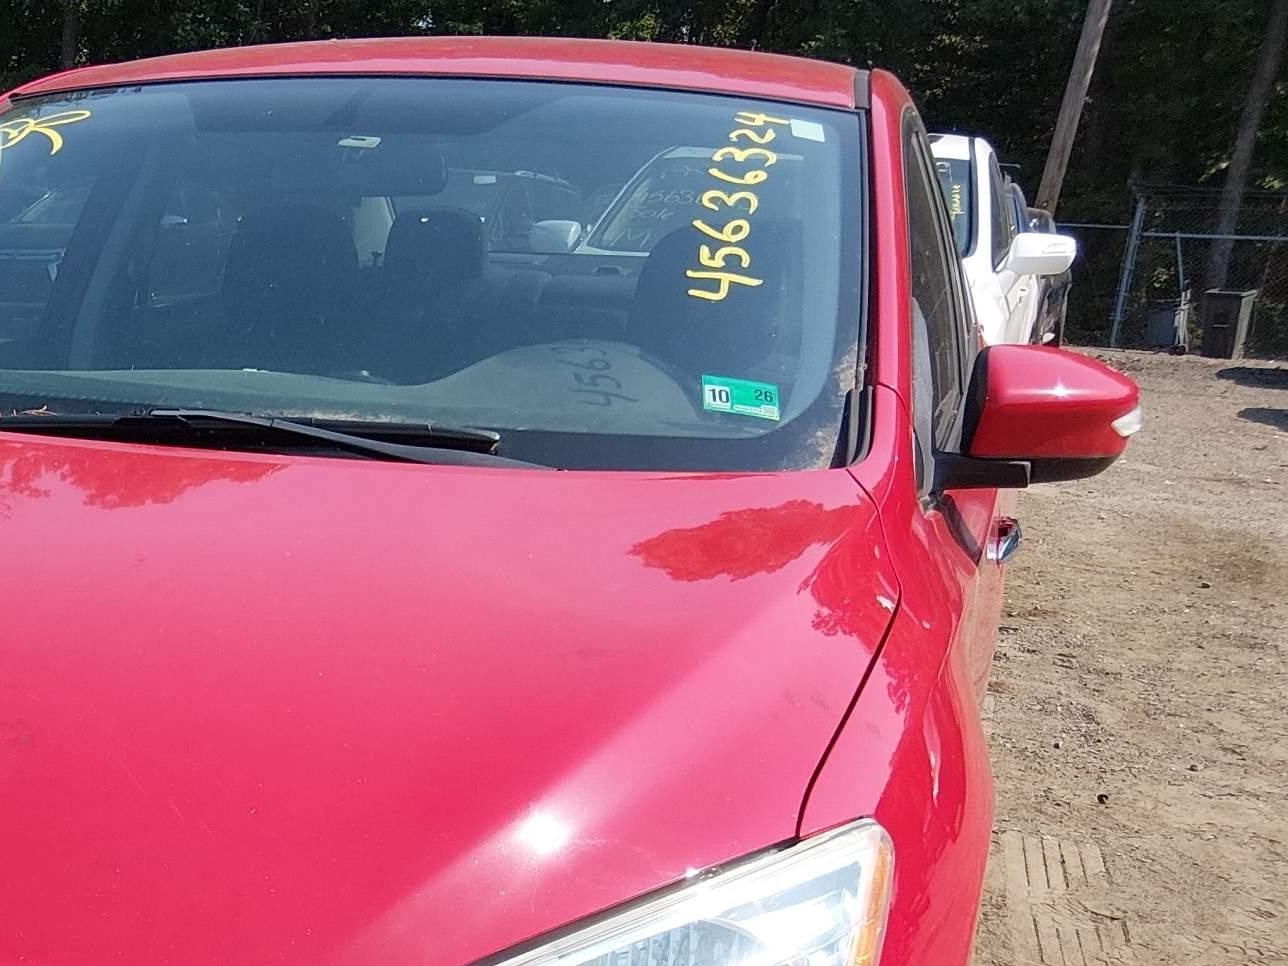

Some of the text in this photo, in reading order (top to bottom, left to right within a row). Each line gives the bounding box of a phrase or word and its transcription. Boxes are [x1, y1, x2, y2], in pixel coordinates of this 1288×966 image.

[685, 110, 792, 302] 45636324
[708, 387, 774, 404] 10 26
